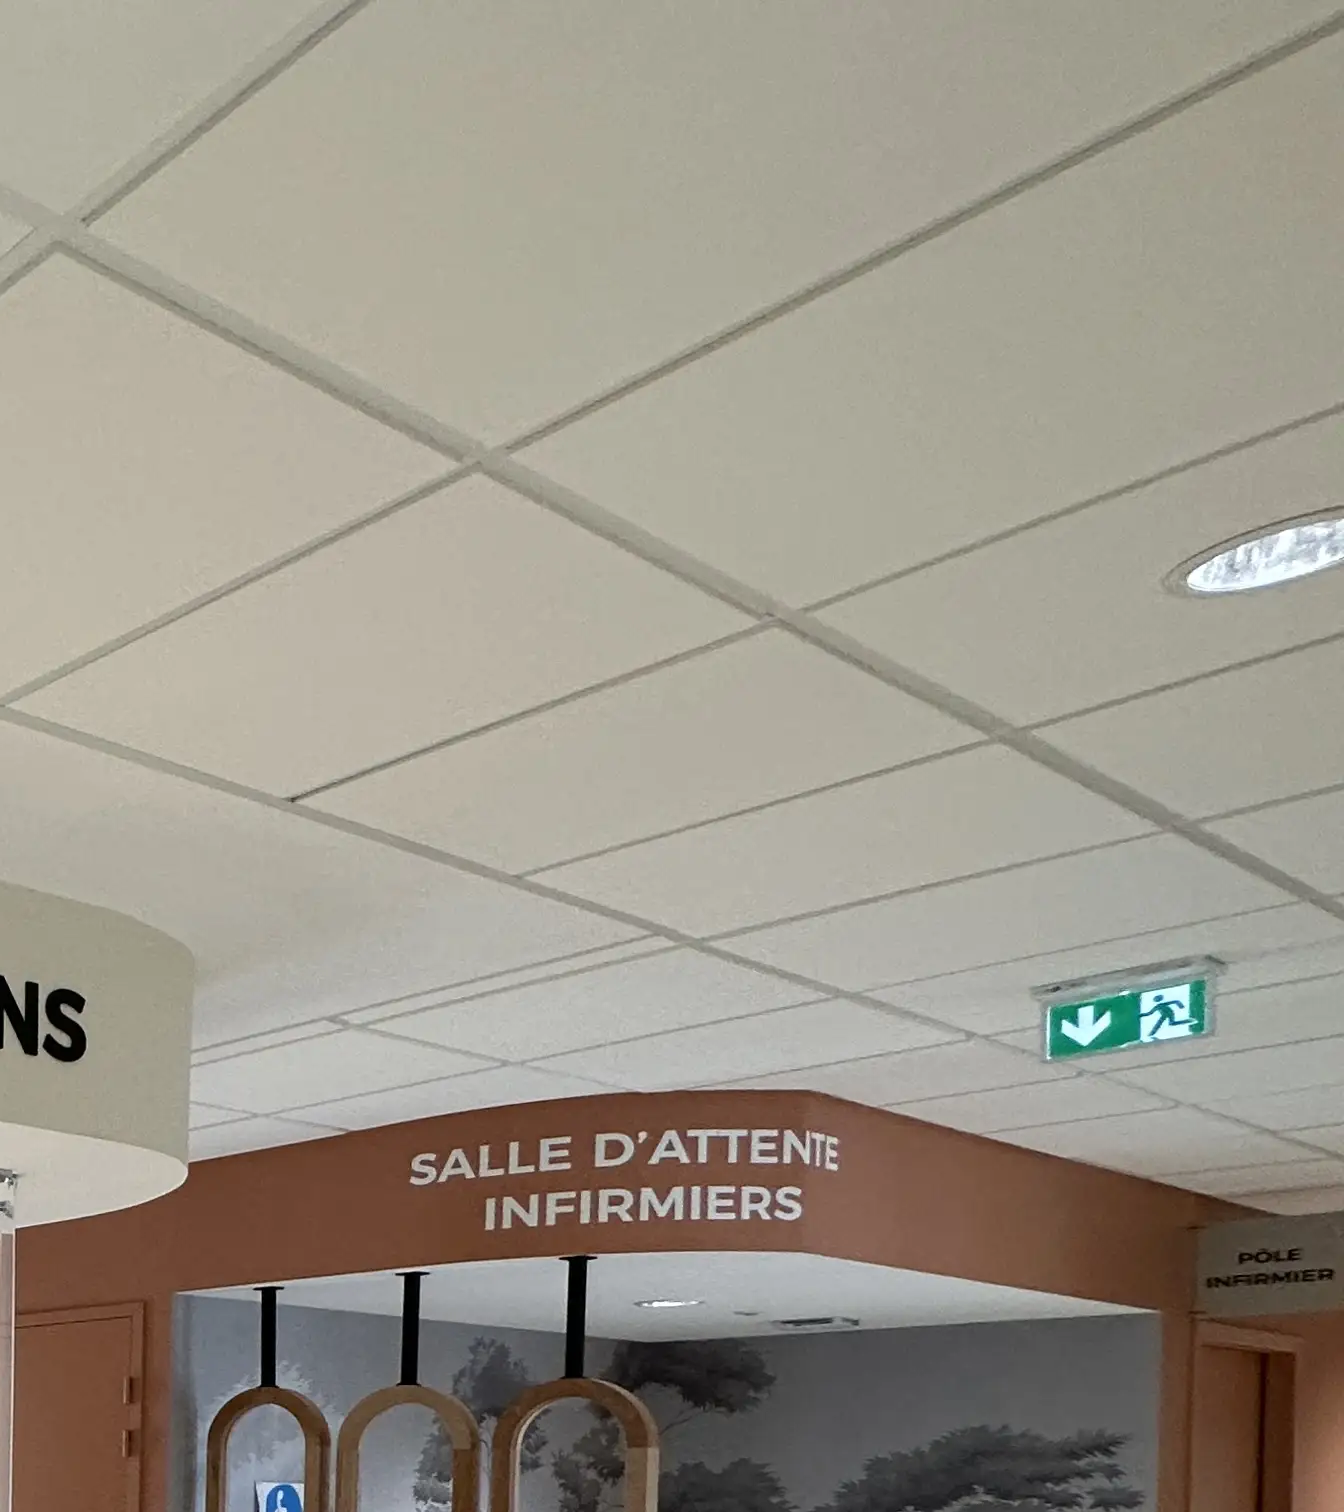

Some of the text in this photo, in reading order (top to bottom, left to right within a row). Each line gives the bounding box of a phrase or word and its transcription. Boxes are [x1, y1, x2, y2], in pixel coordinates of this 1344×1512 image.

[410, 1136, 572, 1185] SALLE
[484, 1186, 802, 1231] INFIRMIERS
[1237, 1248, 1303, 1265] PÔLE
[1206, 1268, 1335, 1288] INFIRMIER
